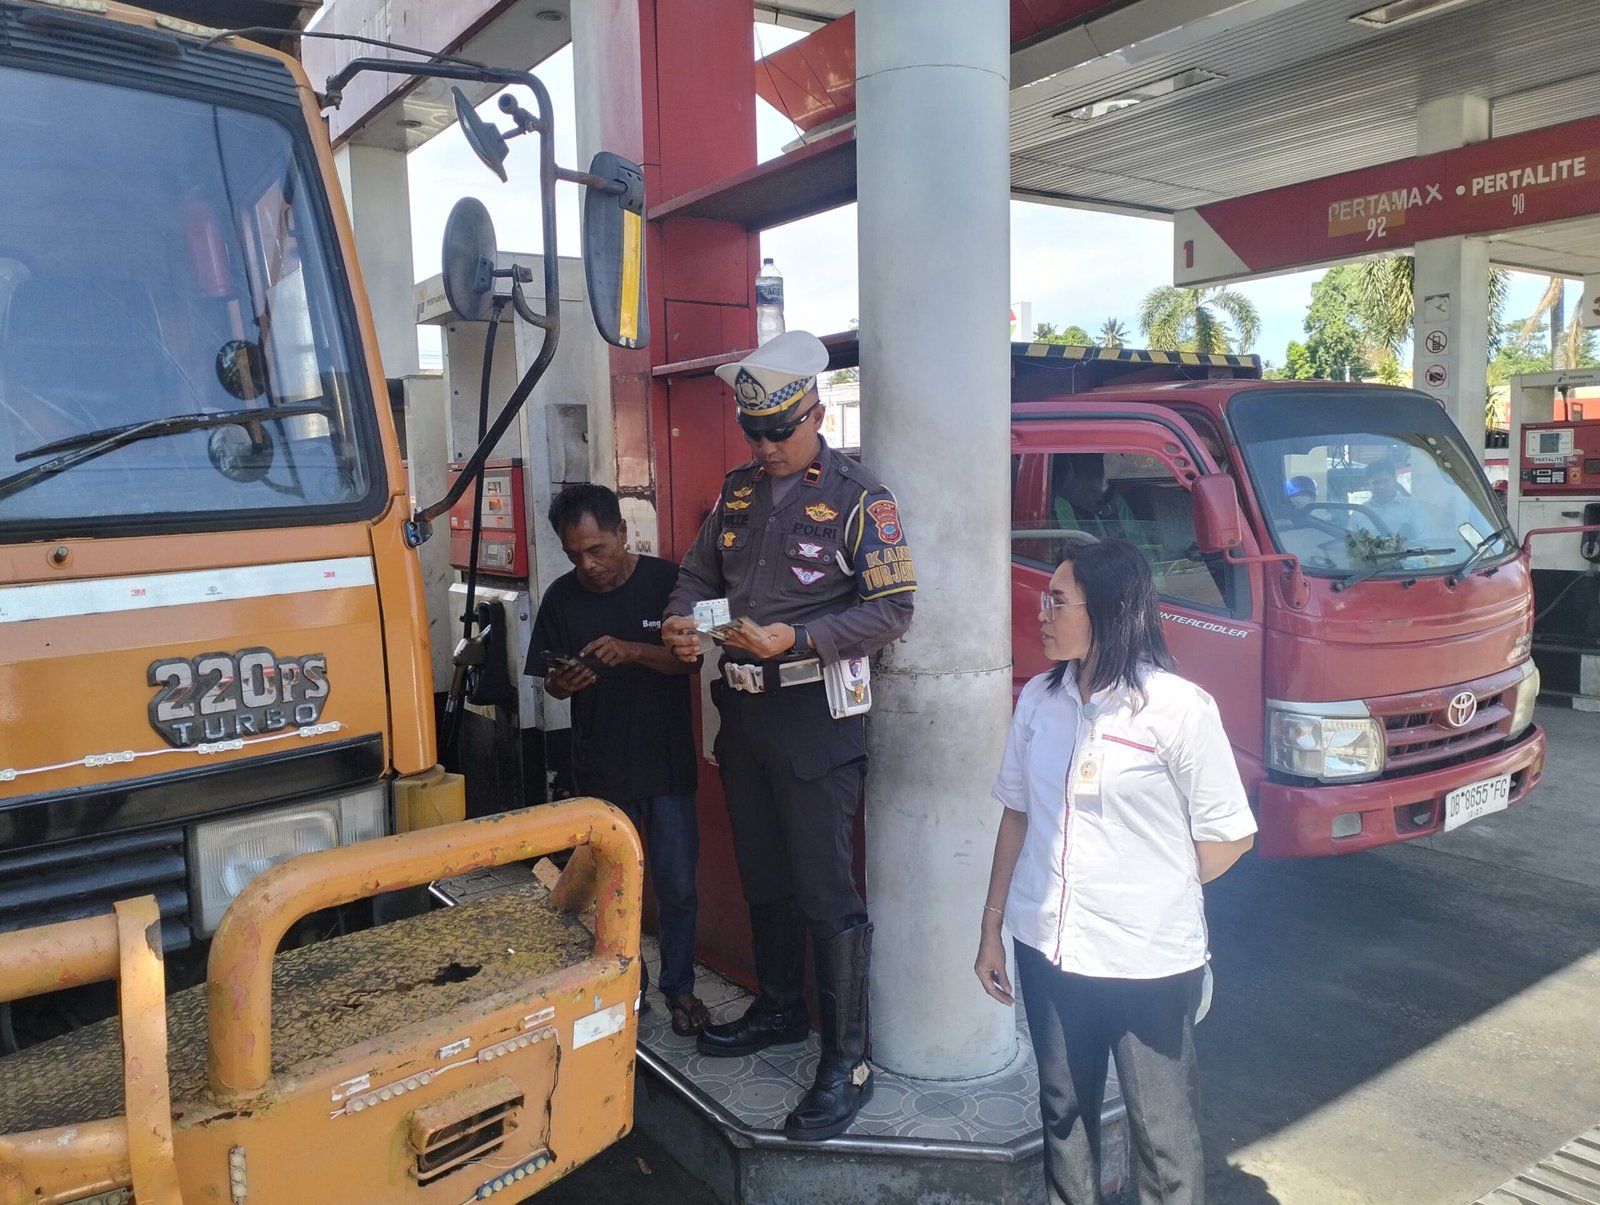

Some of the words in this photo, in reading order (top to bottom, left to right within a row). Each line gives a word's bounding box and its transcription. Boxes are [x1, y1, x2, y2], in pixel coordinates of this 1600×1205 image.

[1327, 183, 1443, 223] PERTAMAX
[1472, 156, 1586, 197] PERTALITE
[1512, 193, 1525, 216] 90
[1365, 216, 1387, 242] 92
[1183, 240, 1194, 268] 1
[792, 523, 837, 541] POLRI
[131, 588, 146, 597] 3M
[171, 702, 319, 744] TURBO
